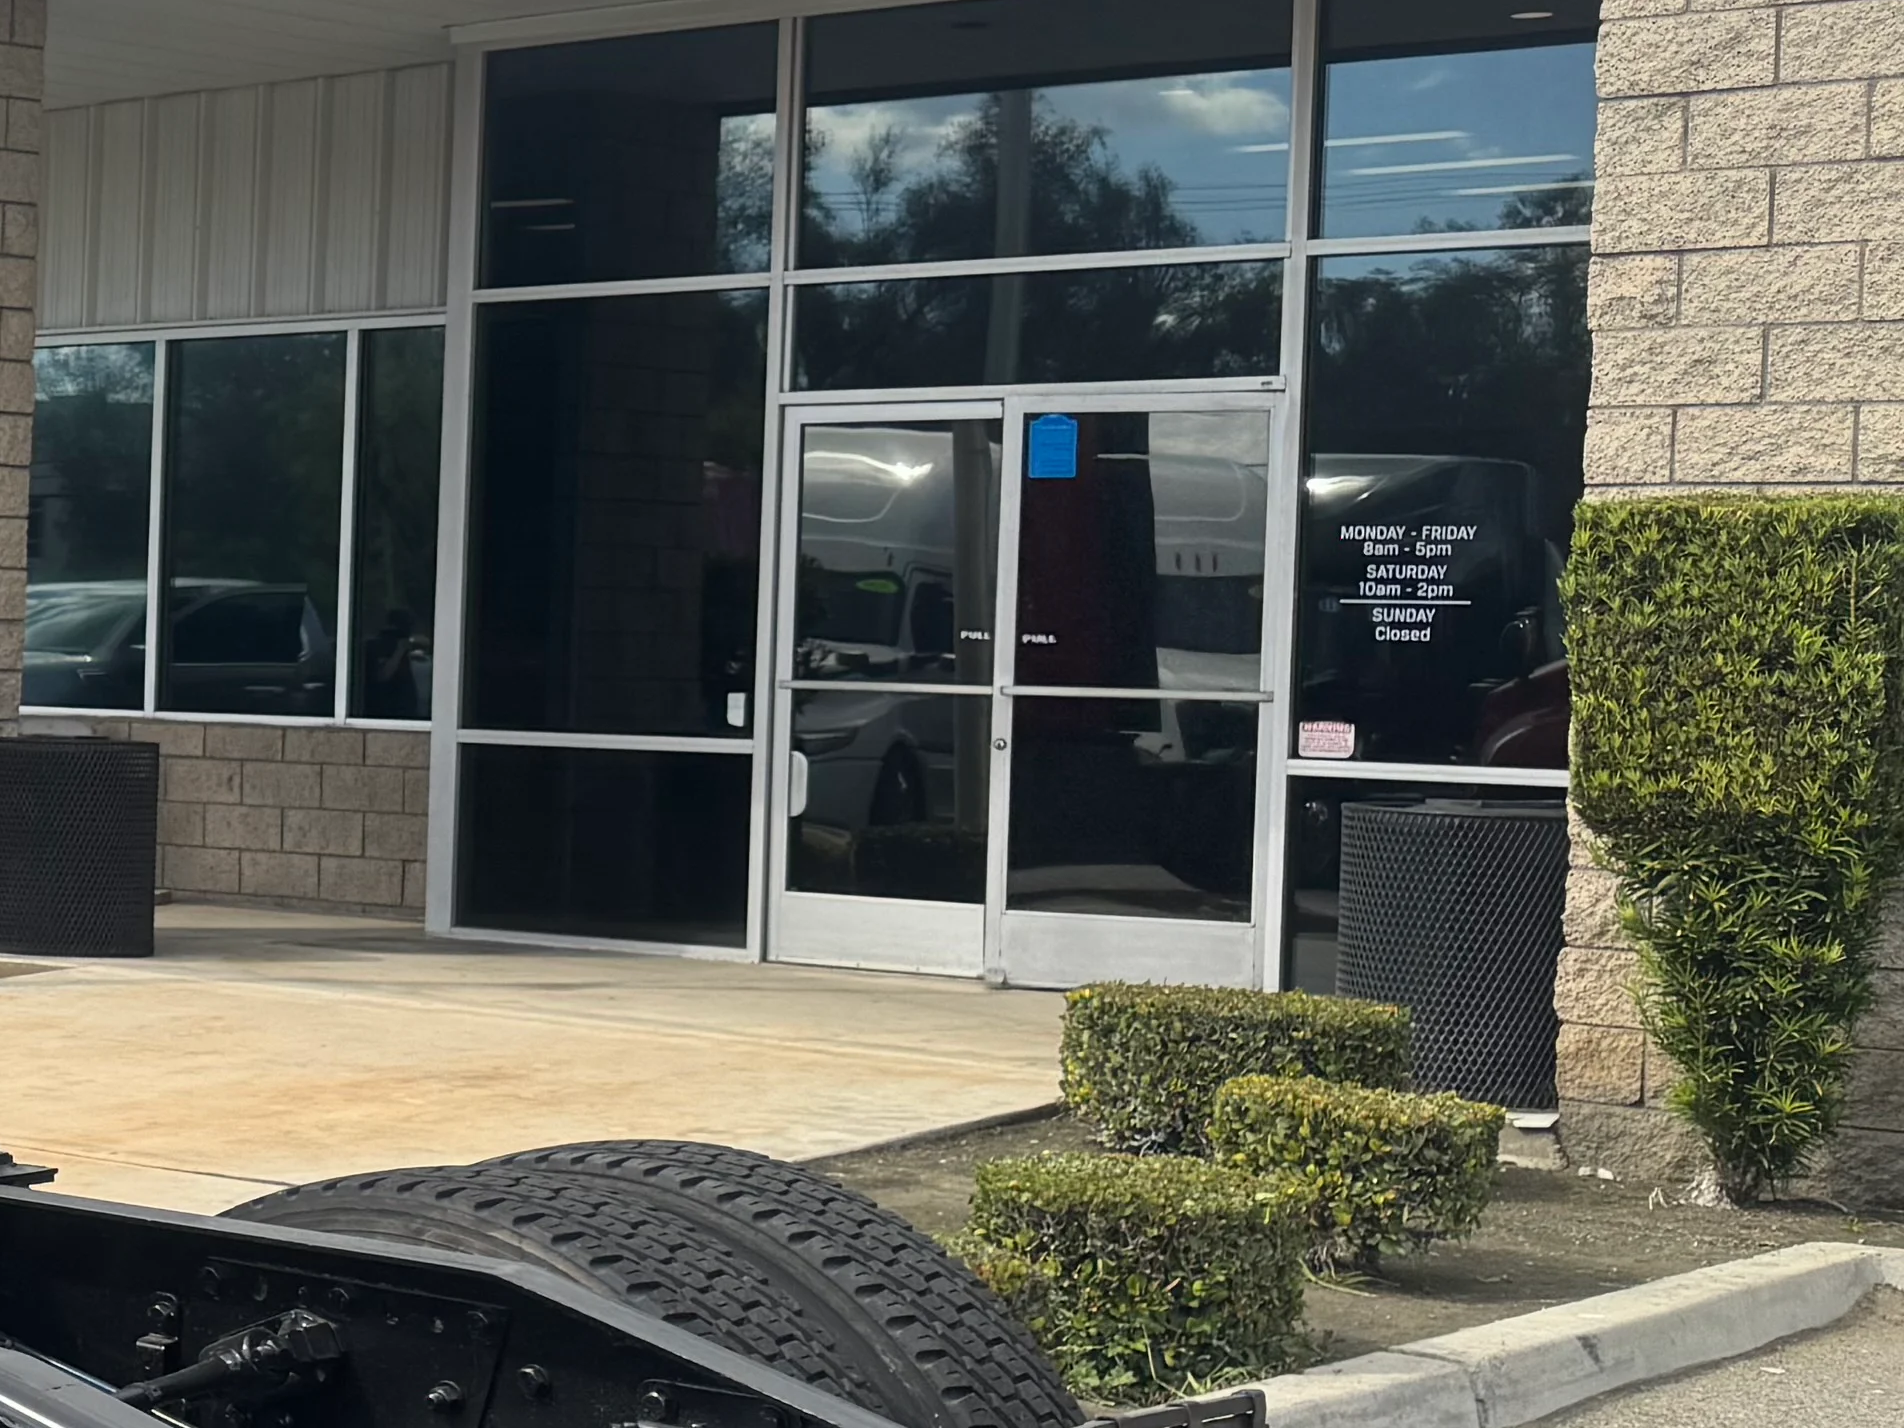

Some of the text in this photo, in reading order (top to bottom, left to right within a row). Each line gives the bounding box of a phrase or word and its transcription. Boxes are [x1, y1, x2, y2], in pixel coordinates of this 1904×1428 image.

[1340, 525, 1406, 541] MONDAY
[1421, 525, 1477, 541] FRIDAY
[1363, 542, 1399, 556] 8am
[1415, 542, 1452, 558] 5pm
[1366, 564, 1447, 579] SATURDAY
[1358, 581, 1401, 596] 10am
[1417, 582, 1454, 599] 2pm
[1372, 608, 1436, 623] SUNDAY
[1375, 627, 1431, 642] Closed
